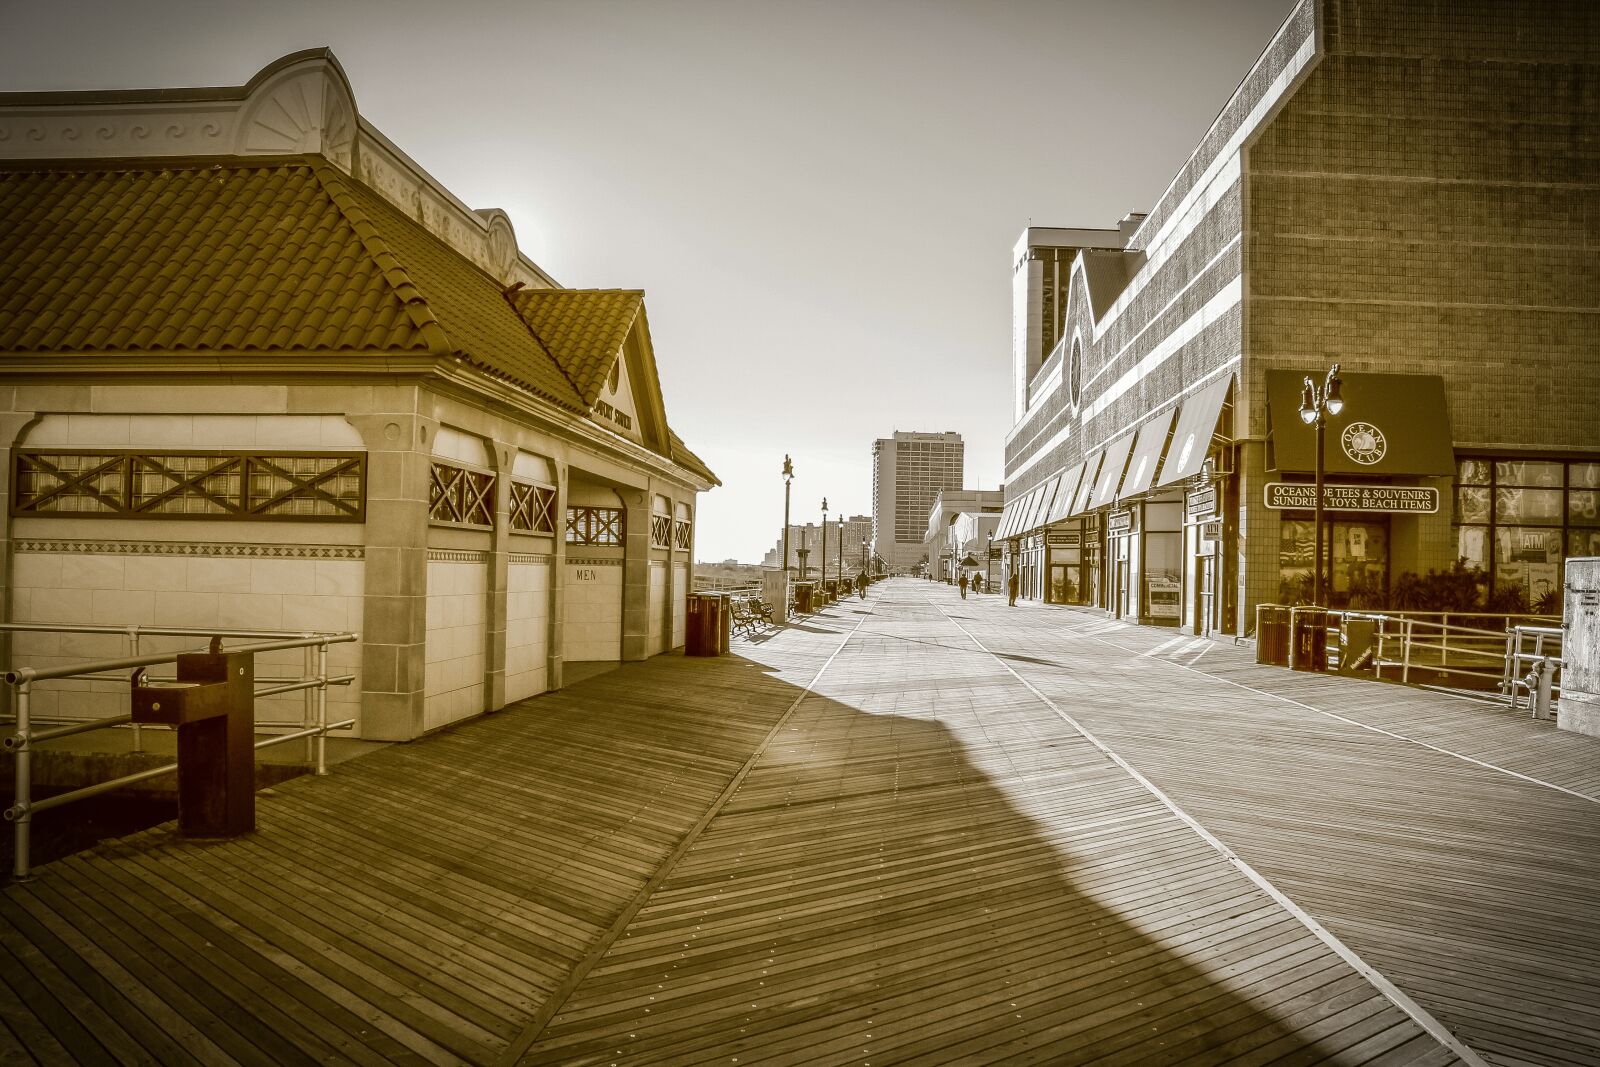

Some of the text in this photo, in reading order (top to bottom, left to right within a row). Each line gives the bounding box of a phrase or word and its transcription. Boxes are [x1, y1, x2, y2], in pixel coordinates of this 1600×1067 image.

[1344, 425, 1383, 443] OCEAN
[1348, 448, 1382, 462] CLUB
[1274, 487, 1431, 500] OCEANSDE TEES & SOUVENIRS
[1273, 496, 1431, 510] SUNDRIE, TOYS, BEACH ITEMS
[1523, 534, 1544, 549] ATM
[576, 569, 596, 581] MEN
